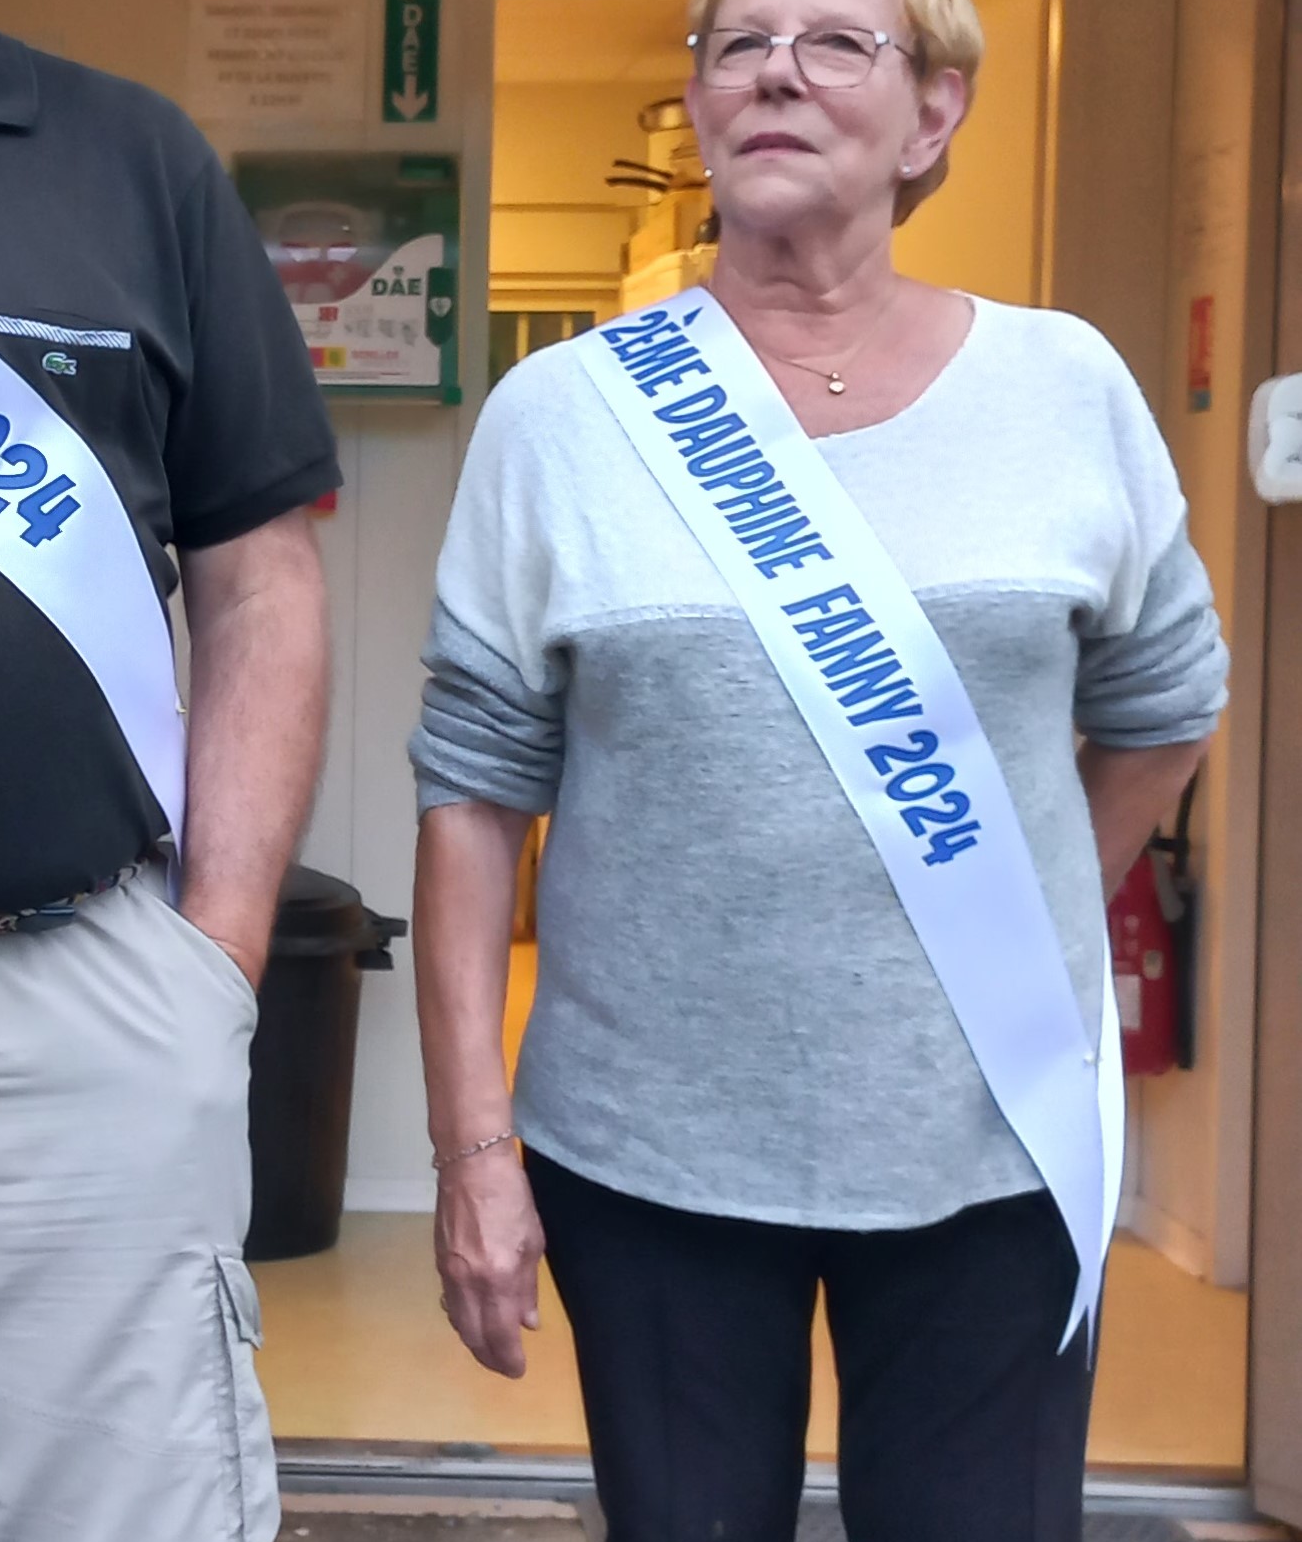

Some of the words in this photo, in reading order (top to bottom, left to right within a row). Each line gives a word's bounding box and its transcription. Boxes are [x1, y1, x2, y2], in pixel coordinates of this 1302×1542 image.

[401, 2, 423, 74] DAE
[371, 278, 422, 296] DAE
[653, 384, 835, 581] DAUPHINE
[780, 583, 925, 728] FANNY
[864, 729, 983, 867] 2024
